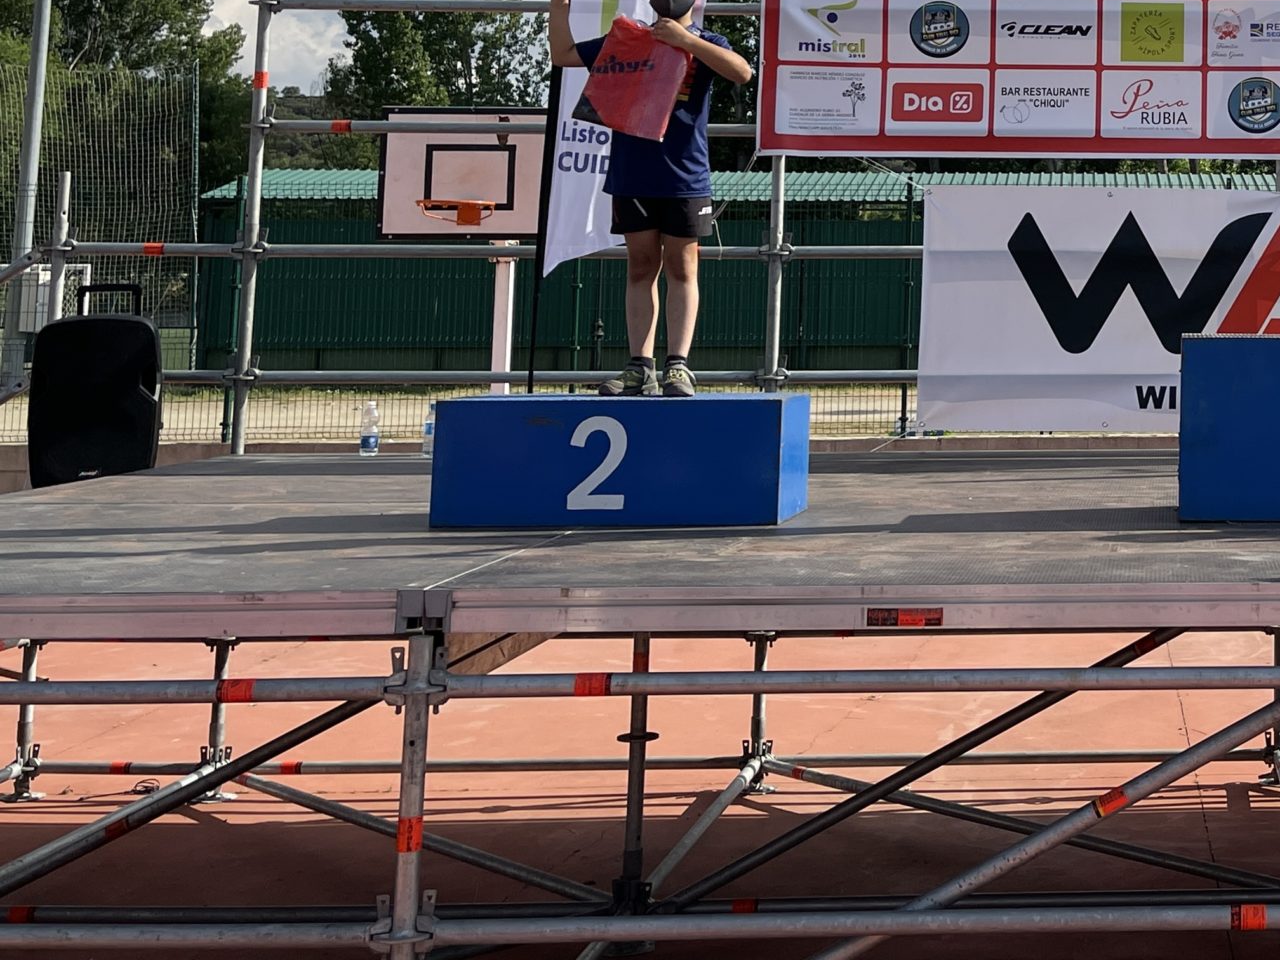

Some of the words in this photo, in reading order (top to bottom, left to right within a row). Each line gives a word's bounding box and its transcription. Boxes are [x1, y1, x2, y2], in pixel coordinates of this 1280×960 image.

[1018, 25, 1093, 37] CLEAN
[798, 38, 866, 53] mistral
[1001, 87, 1020, 96] BAR
[1023, 87, 1090, 97] RESTAURANTE
[1029, 99, 1069, 108] "CHIQUI"
[1140, 111, 1188, 125] RUBIA
[561, 121, 610, 146] Listo
[558, 151, 611, 175] CUID
[566, 416, 628, 510] 2
